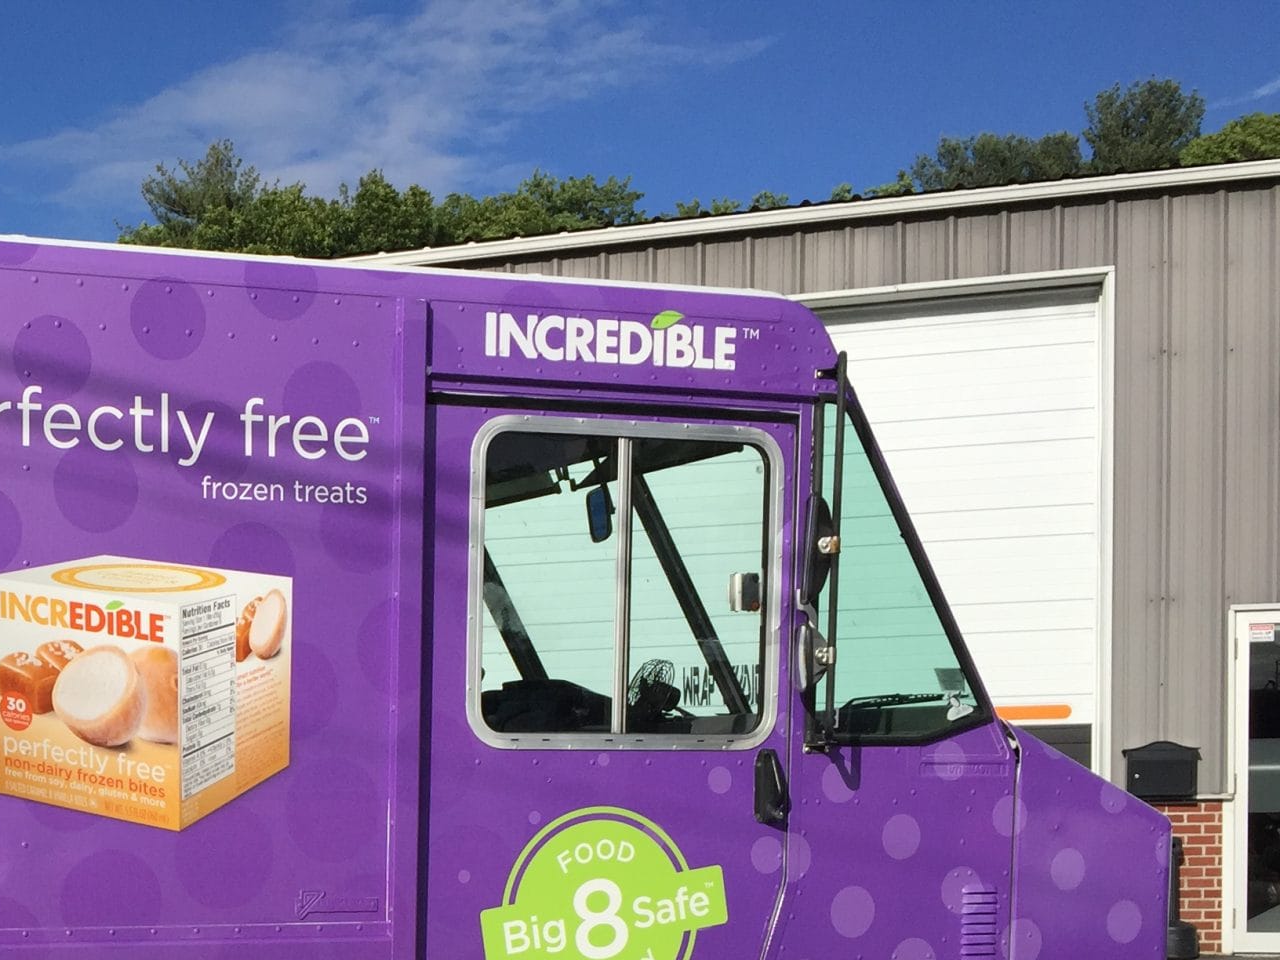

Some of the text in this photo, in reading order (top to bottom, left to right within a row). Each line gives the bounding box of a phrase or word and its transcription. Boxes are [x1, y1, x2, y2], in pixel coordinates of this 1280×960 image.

[485, 311, 737, 371] INCREDIBLE
[240, 397, 370, 462] free
[201, 475, 368, 505] frozen treats
[0, 590, 165, 643] INCREDIBLE
[182, 599, 231, 618] Nutrition Facts
[6, 696, 26, 712] 30
[3, 735, 165, 783] perfectly free
[4, 756, 166, 798] non-dairy frozen bites
[5, 767, 23, 779] free
[25, 771, 47, 783] from
[70, 780, 96, 795] dairy,
[99, 788, 128, 801] gluten
[130, 793, 138, 802] &
[140, 795, 166, 808] more
[556, 838, 635, 874] FOOD
[502, 915, 567, 955] Big
[573, 878, 629, 960] 8
[632, 886, 710, 928] Safe
